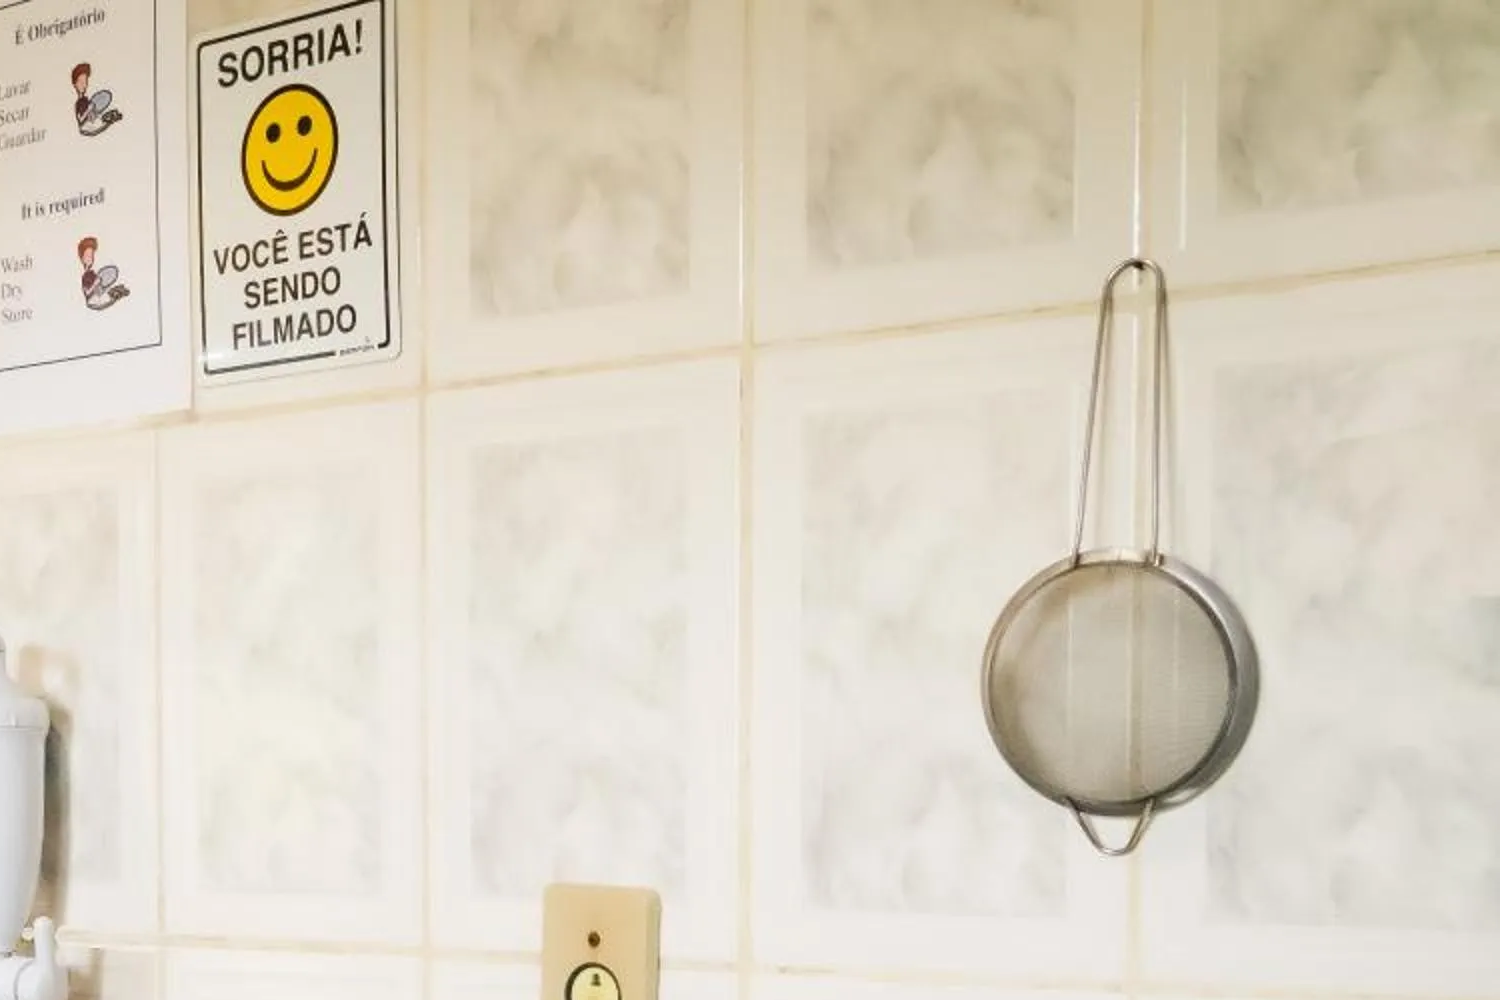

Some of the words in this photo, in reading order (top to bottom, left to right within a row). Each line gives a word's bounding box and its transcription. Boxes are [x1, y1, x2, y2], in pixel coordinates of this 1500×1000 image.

[15, 26, 24, 45] É
[28, 9, 105, 43] Obrigatório
[218, 19, 363, 88] SORRIA!
[21, 202, 31, 220] It
[35, 202, 45, 216] is
[50, 187, 105, 216] required
[213, 229, 289, 275] VOCÊ
[299, 211, 373, 260] ESTÁ
[1, 255, 33, 273] Wash
[1, 283, 23, 302] Dry
[244, 266, 341, 309] SENDO
[232, 304, 357, 350] FILMADO
